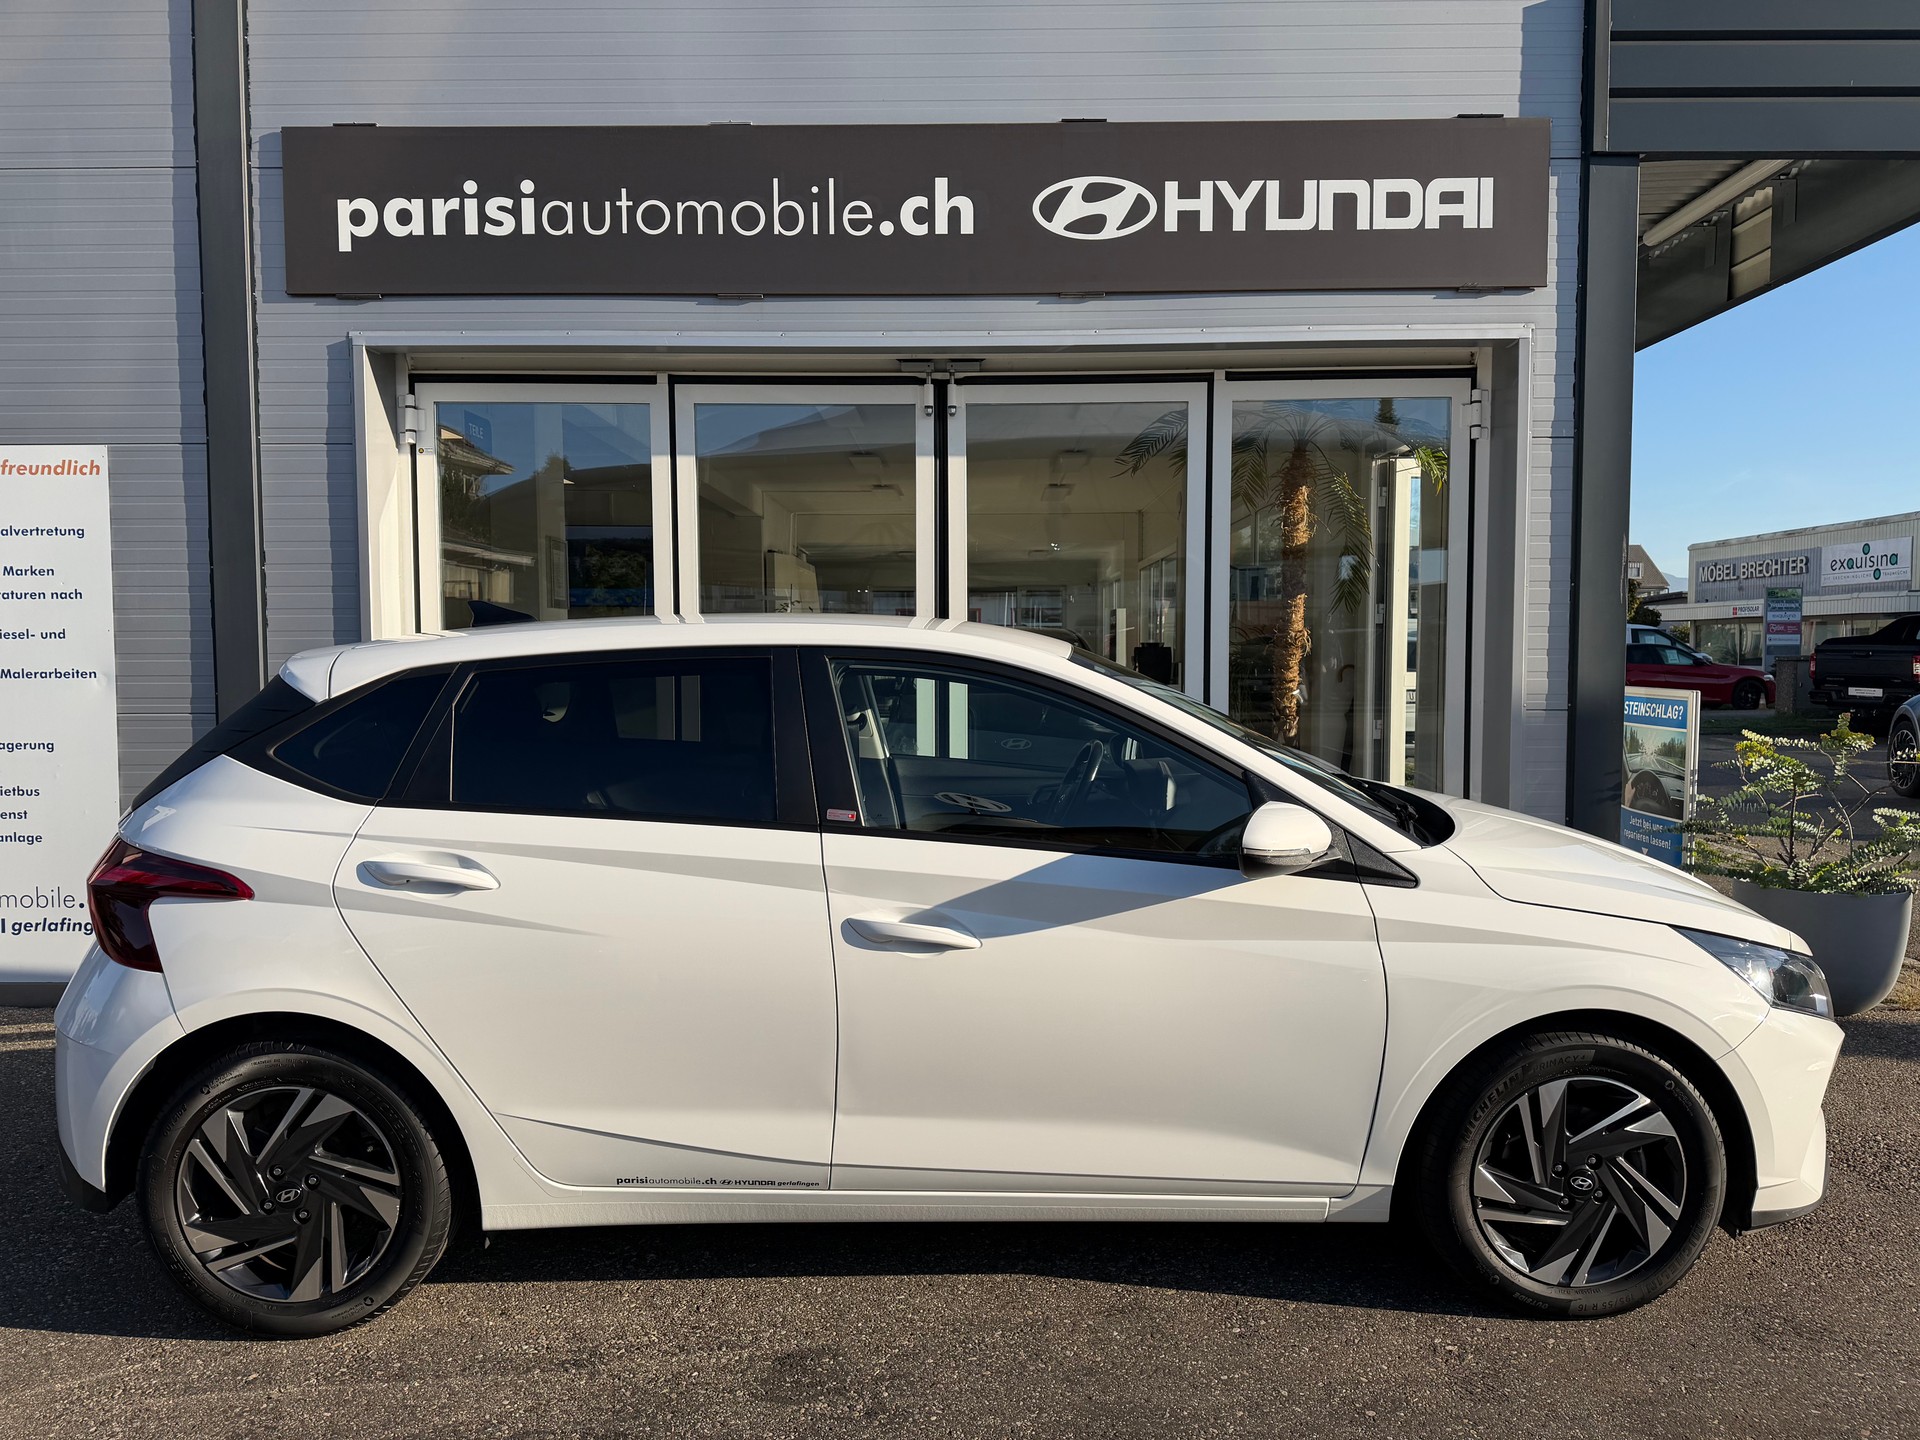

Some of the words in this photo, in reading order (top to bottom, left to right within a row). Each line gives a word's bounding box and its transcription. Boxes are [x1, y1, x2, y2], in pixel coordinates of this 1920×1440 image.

[336, 177, 975, 252] parisiautomobile.ch
[1164, 176, 1494, 232] HYUNDAI
[0, 458, 101, 476] freundlich
[0, 524, 85, 539] alvertretung
[2, 565, 55, 576] Marken
[1700, 562, 1737, 583] MÖBEL
[1740, 556, 1807, 579] BRECHTER
[51, 588, 83, 600] nach
[0, 628, 36, 640] iesel-
[40, 628, 66, 640] und
[0, 668, 97, 679] Malerarbeiten
[1624, 701, 1684, 720] STEINSCHLAG?
[0, 786, 40, 796] ietbus
[0, 810, 28, 820] enst
[1629, 815, 1642, 828] Jetzt
[1642, 819, 1652, 830] bei
[1624, 828, 1649, 843] reparieren
[1650, 835, 1671, 850] lassen!
[616, 1176, 717, 1186] parisiautomobile.ch
